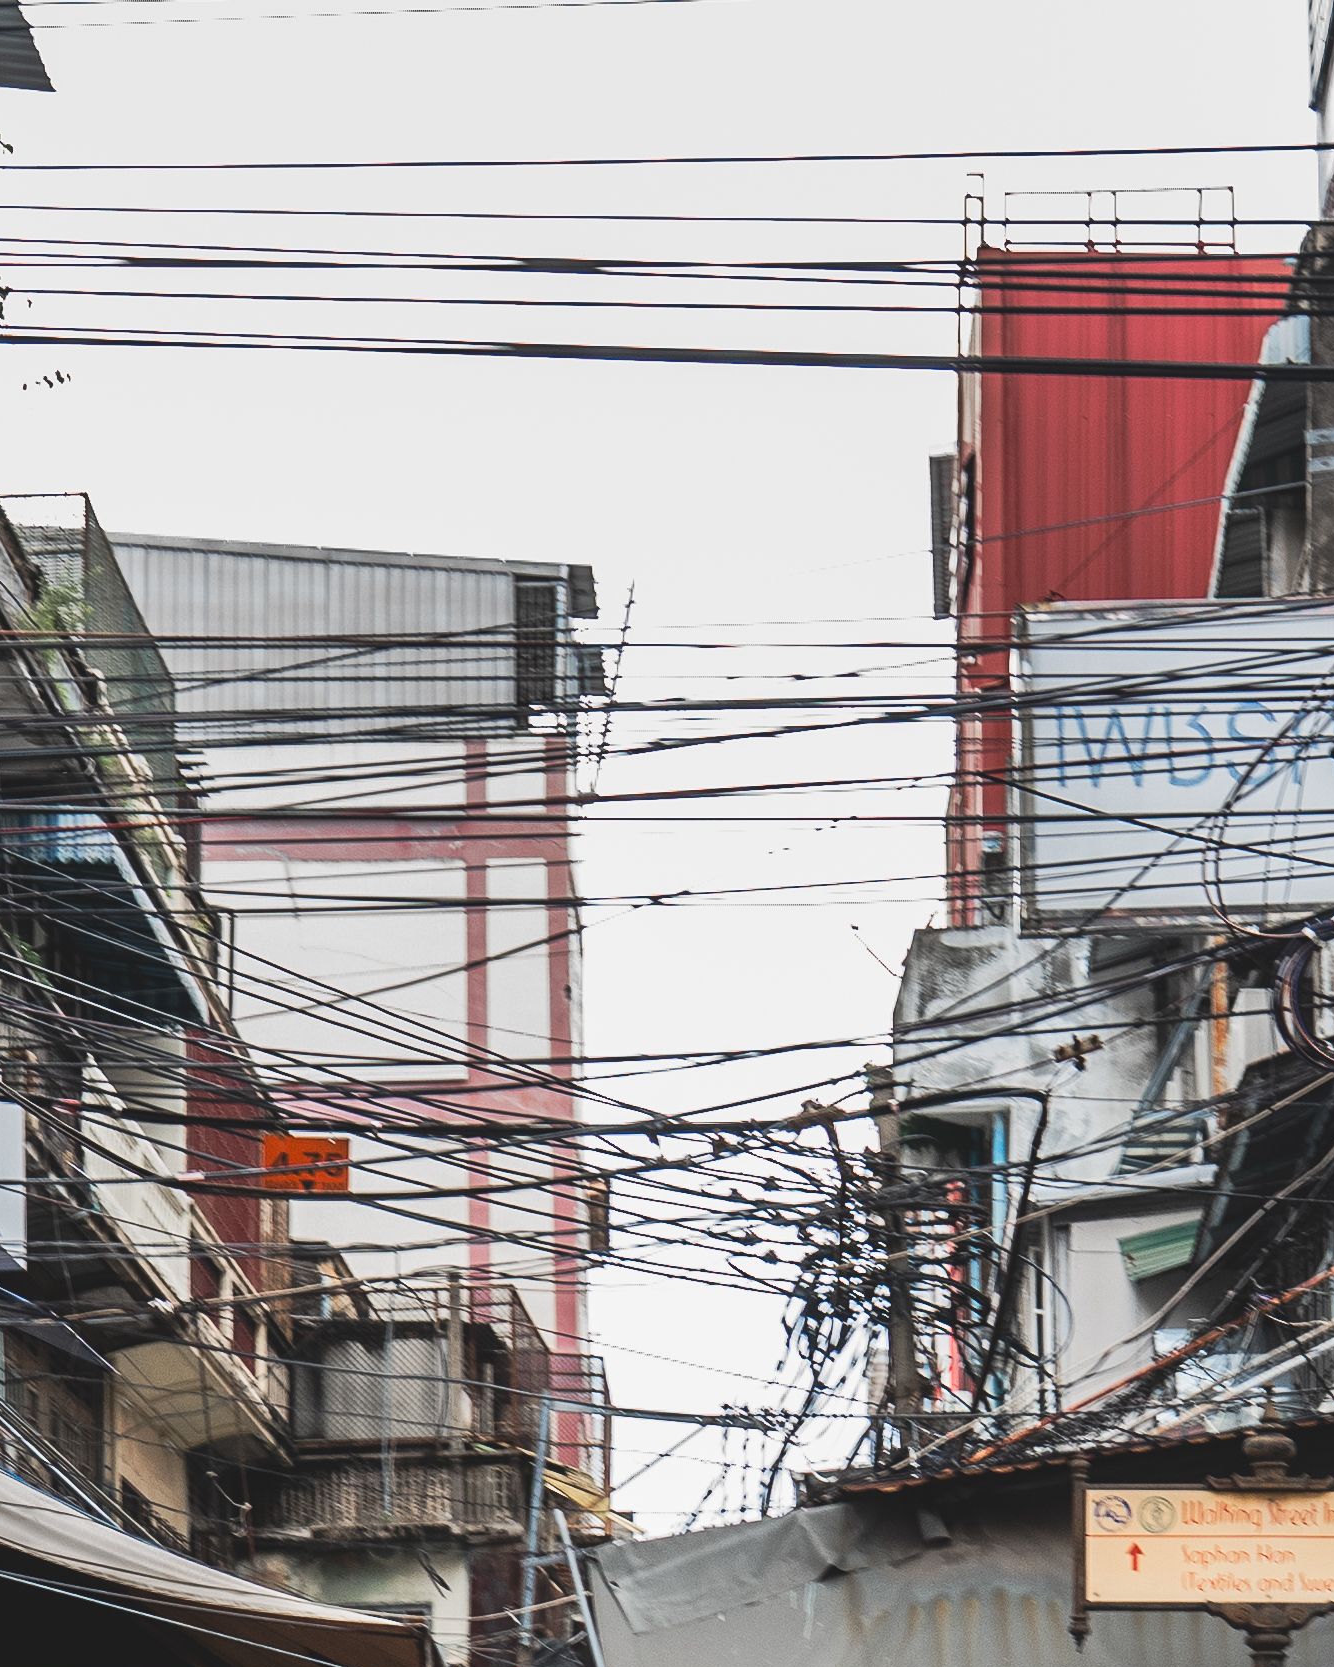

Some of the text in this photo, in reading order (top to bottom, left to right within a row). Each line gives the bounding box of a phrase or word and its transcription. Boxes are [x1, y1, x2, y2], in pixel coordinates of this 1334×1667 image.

[1181, 1500, 1263, 1531] Walking
[1269, 1502, 1317, 1527] Street
[1181, 1544, 1297, 1569] Saphan Han
[1181, 1571, 1252, 1593] (Textiles
[1257, 1573, 1294, 1593] and
